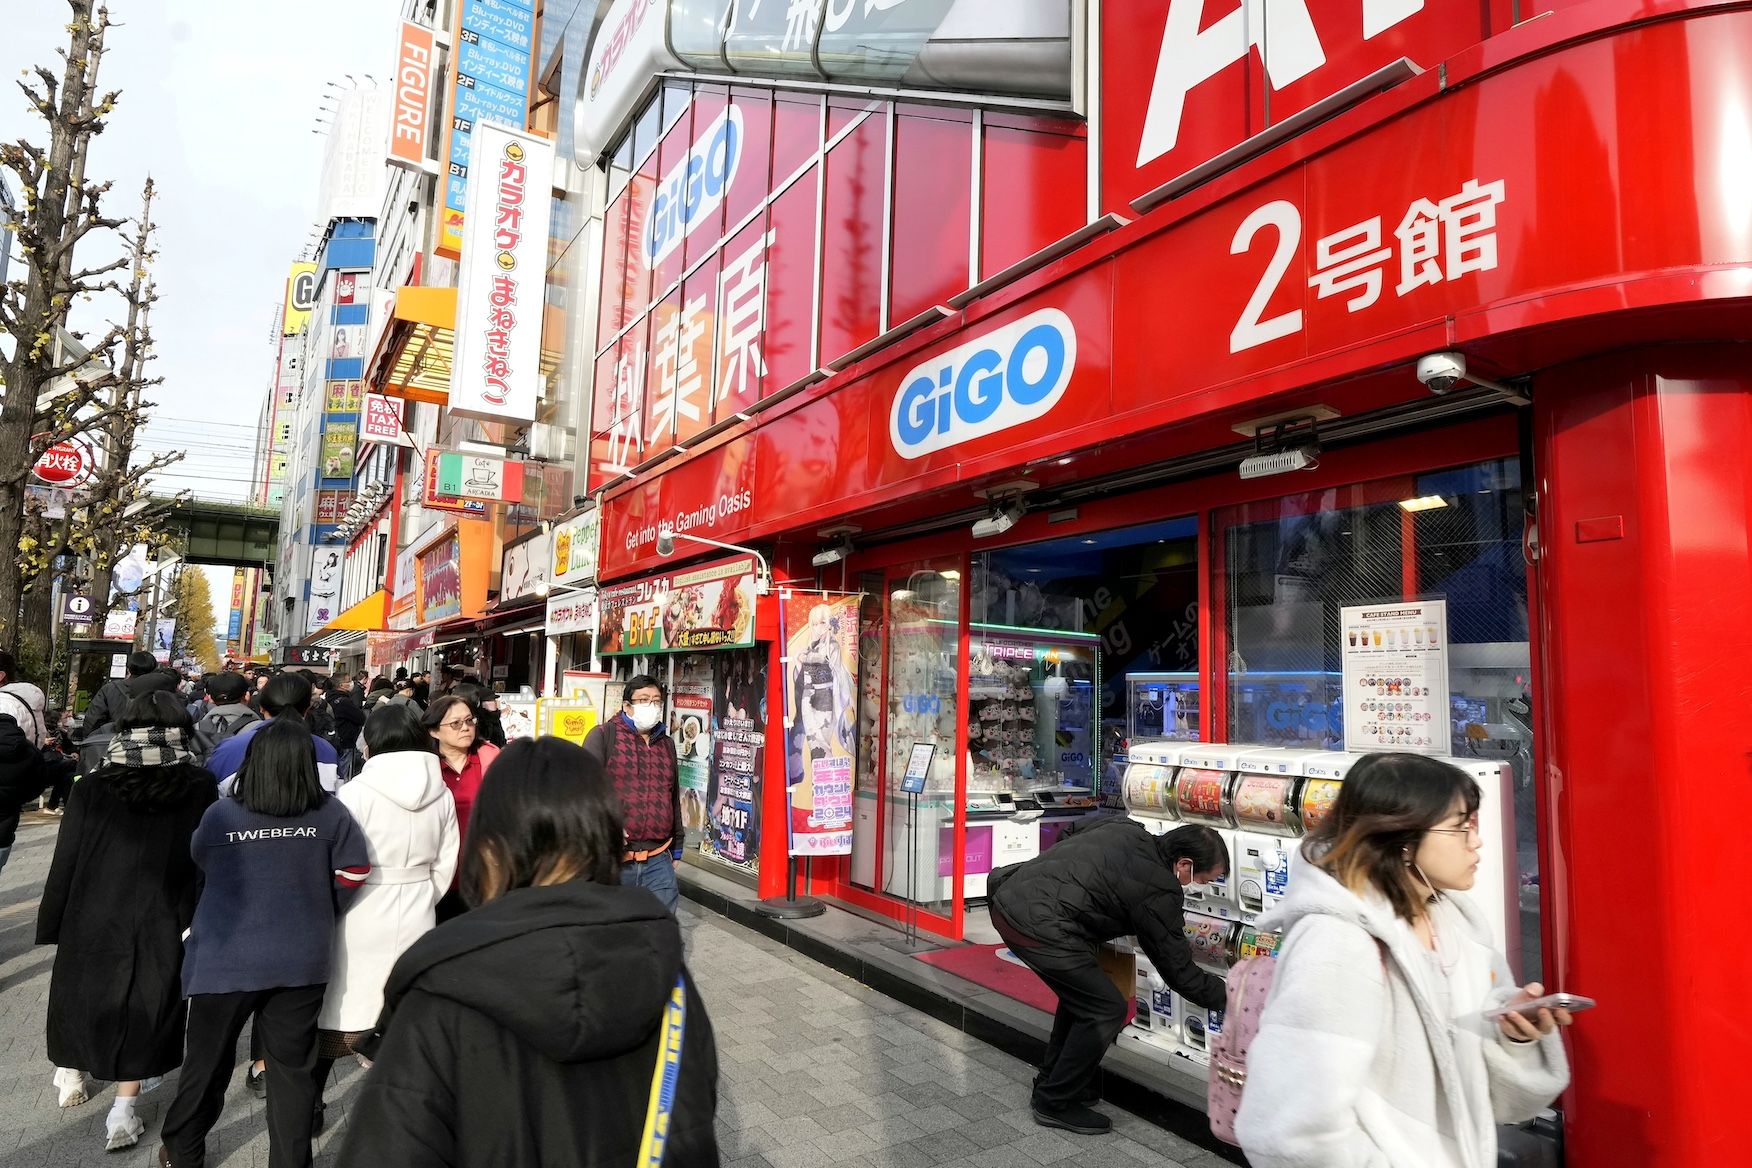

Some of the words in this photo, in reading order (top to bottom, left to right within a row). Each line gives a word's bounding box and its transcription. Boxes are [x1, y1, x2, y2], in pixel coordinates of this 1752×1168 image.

[461, 30, 478, 45] 3F
[457, 74, 475, 88] 2F
[396, 41, 428, 145] FIGURE
[449, 163, 467, 177] B1
[645, 119, 738, 259] GiGO
[495, 160, 527, 251] カラオケ
[1229, 177, 1506, 355] 2号館
[480, 272, 519, 406] まねきねこ
[606, 227, 777, 469] 秋葉原
[898, 324, 1066, 446] GiGO
[370, 400, 398, 414] 免税
[369, 413, 396, 427] TAX
[367, 423, 396, 437] FREE
[443, 483, 457, 492] B1
[466, 488, 496, 498] ARCADIA
[626, 528, 640, 551] Get
[639, 526, 656, 546] into
[657, 520, 674, 536] the
[676, 504, 716, 533] Gaming
[718, 487, 751, 517] Oasis
[629, 608, 645, 647] B1
[984, 643, 1033, 659] TRIPLE
[1061, 752, 1084, 762] GiGO
[225, 827, 317, 843] TWEBEAR
